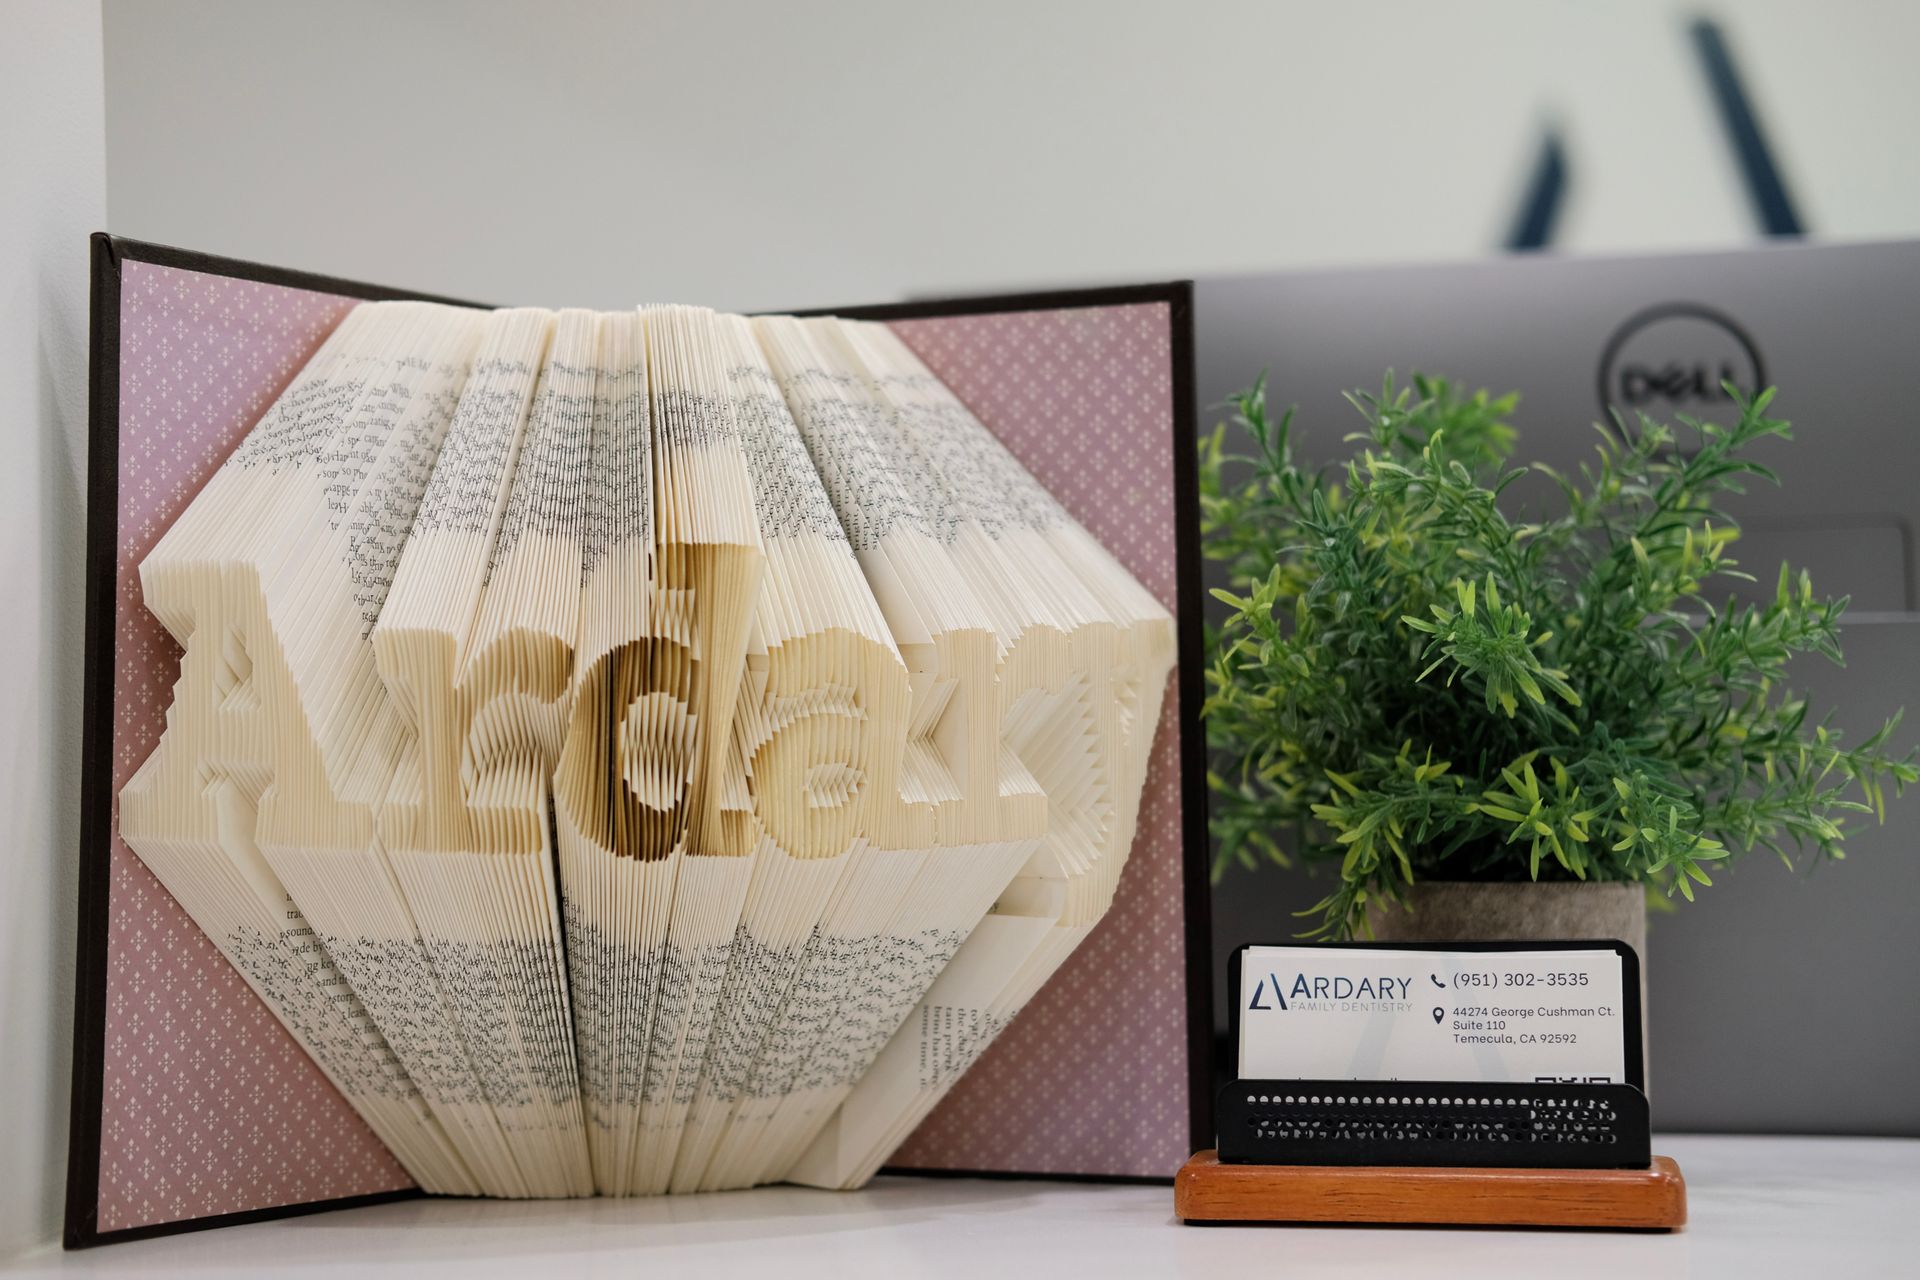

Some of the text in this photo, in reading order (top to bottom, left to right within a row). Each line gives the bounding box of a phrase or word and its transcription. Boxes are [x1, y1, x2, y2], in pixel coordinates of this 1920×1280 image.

[1620, 362, 1741, 404] DELL
[1290, 973, 1412, 1000] ARDARY
[1453, 972, 1589, 990] (951) 302-3535
[1290, 1002, 1413, 1012] FAMILY DENTISTRY
[1453, 1006, 1615, 1019] 44274 George Cushman Ct.
[1453, 1020, 1506, 1030] Suite 110
[1453, 1033, 1577, 1045] Temecula, CA 92592
